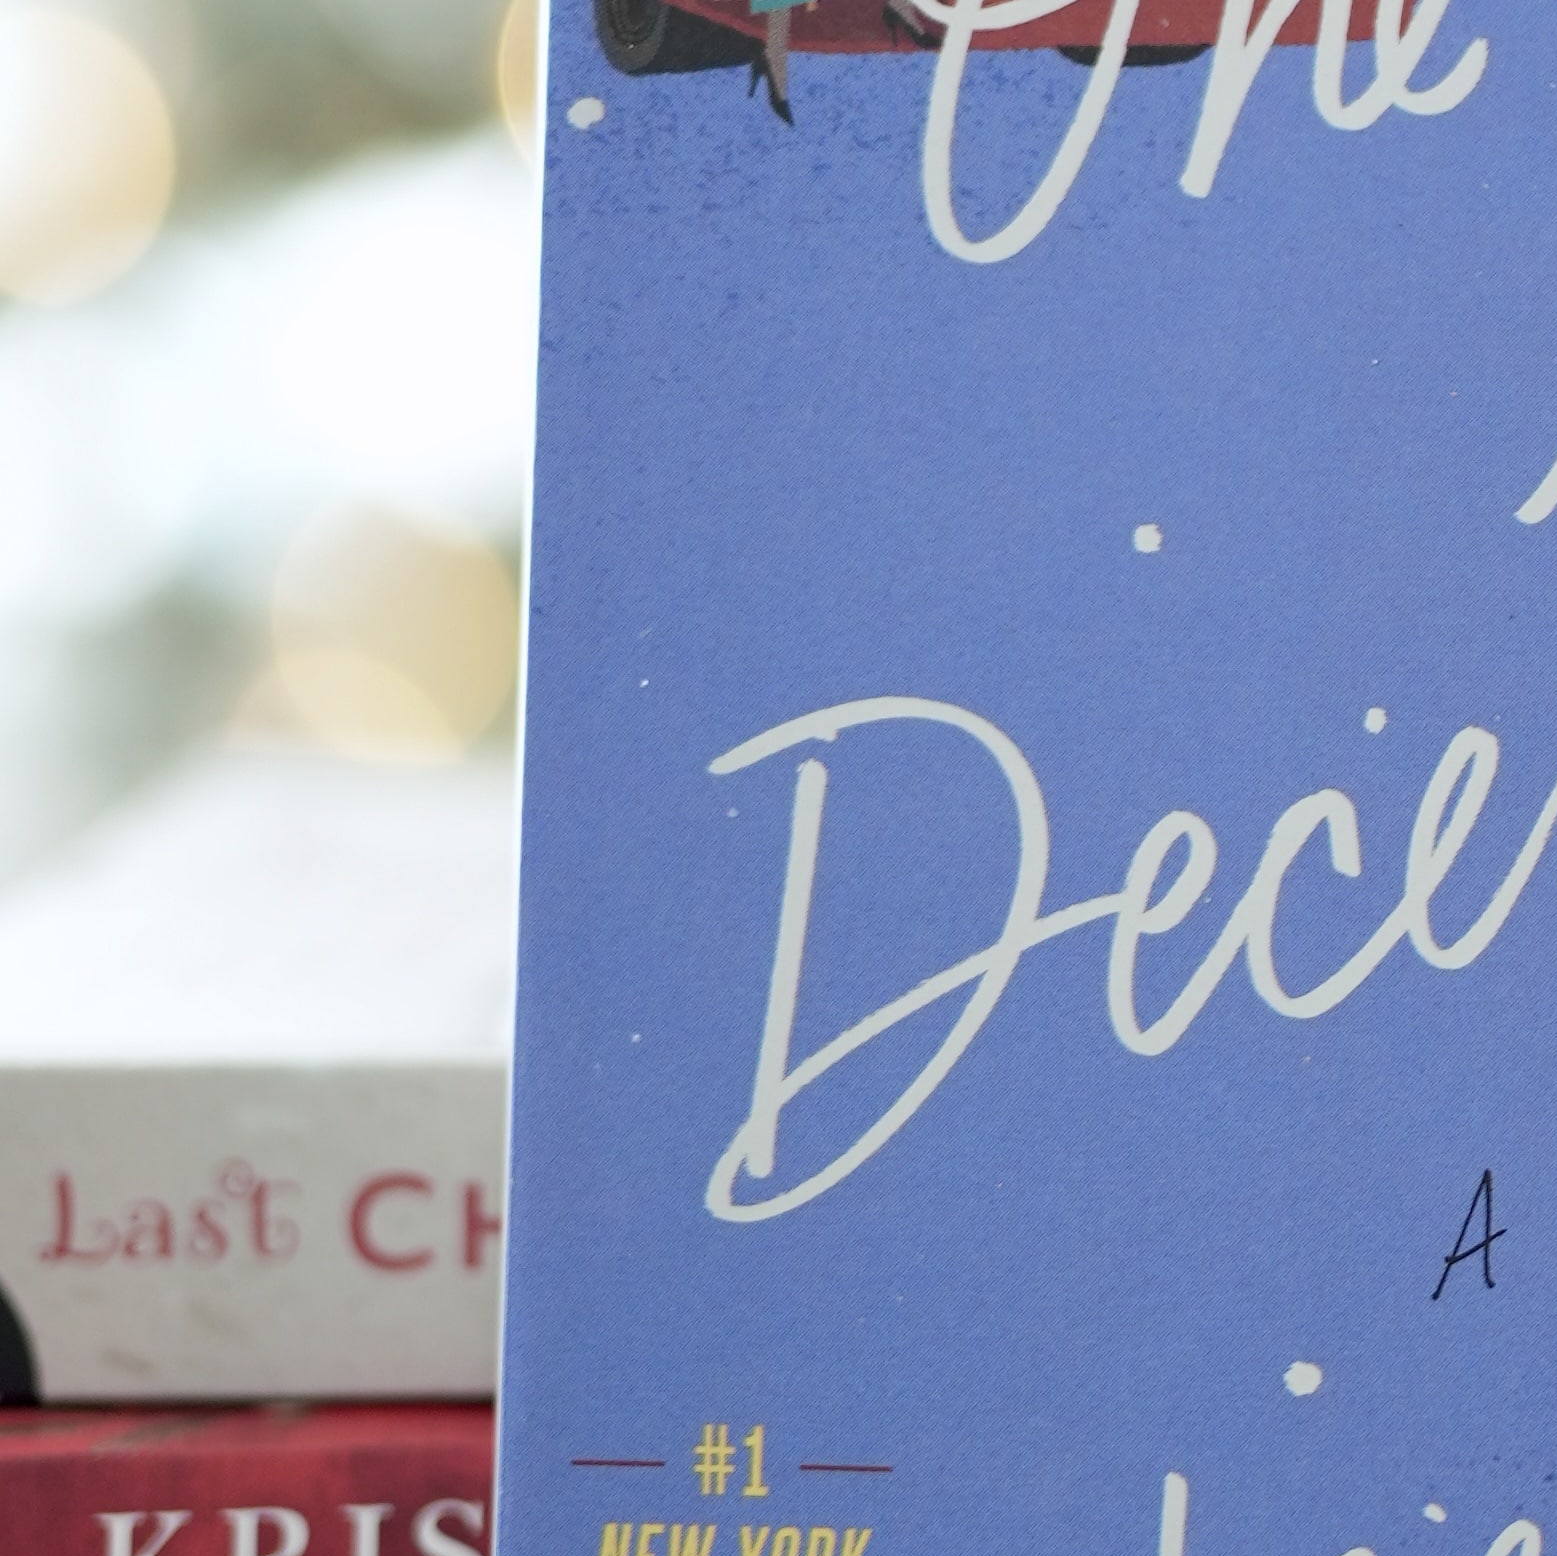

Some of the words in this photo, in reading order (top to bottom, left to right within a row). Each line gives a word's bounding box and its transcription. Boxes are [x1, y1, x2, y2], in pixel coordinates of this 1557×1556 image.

[37, 1156, 305, 1268] Last
[1433, 1169, 1505, 1300] A
[693, 1424, 769, 1497] #1
